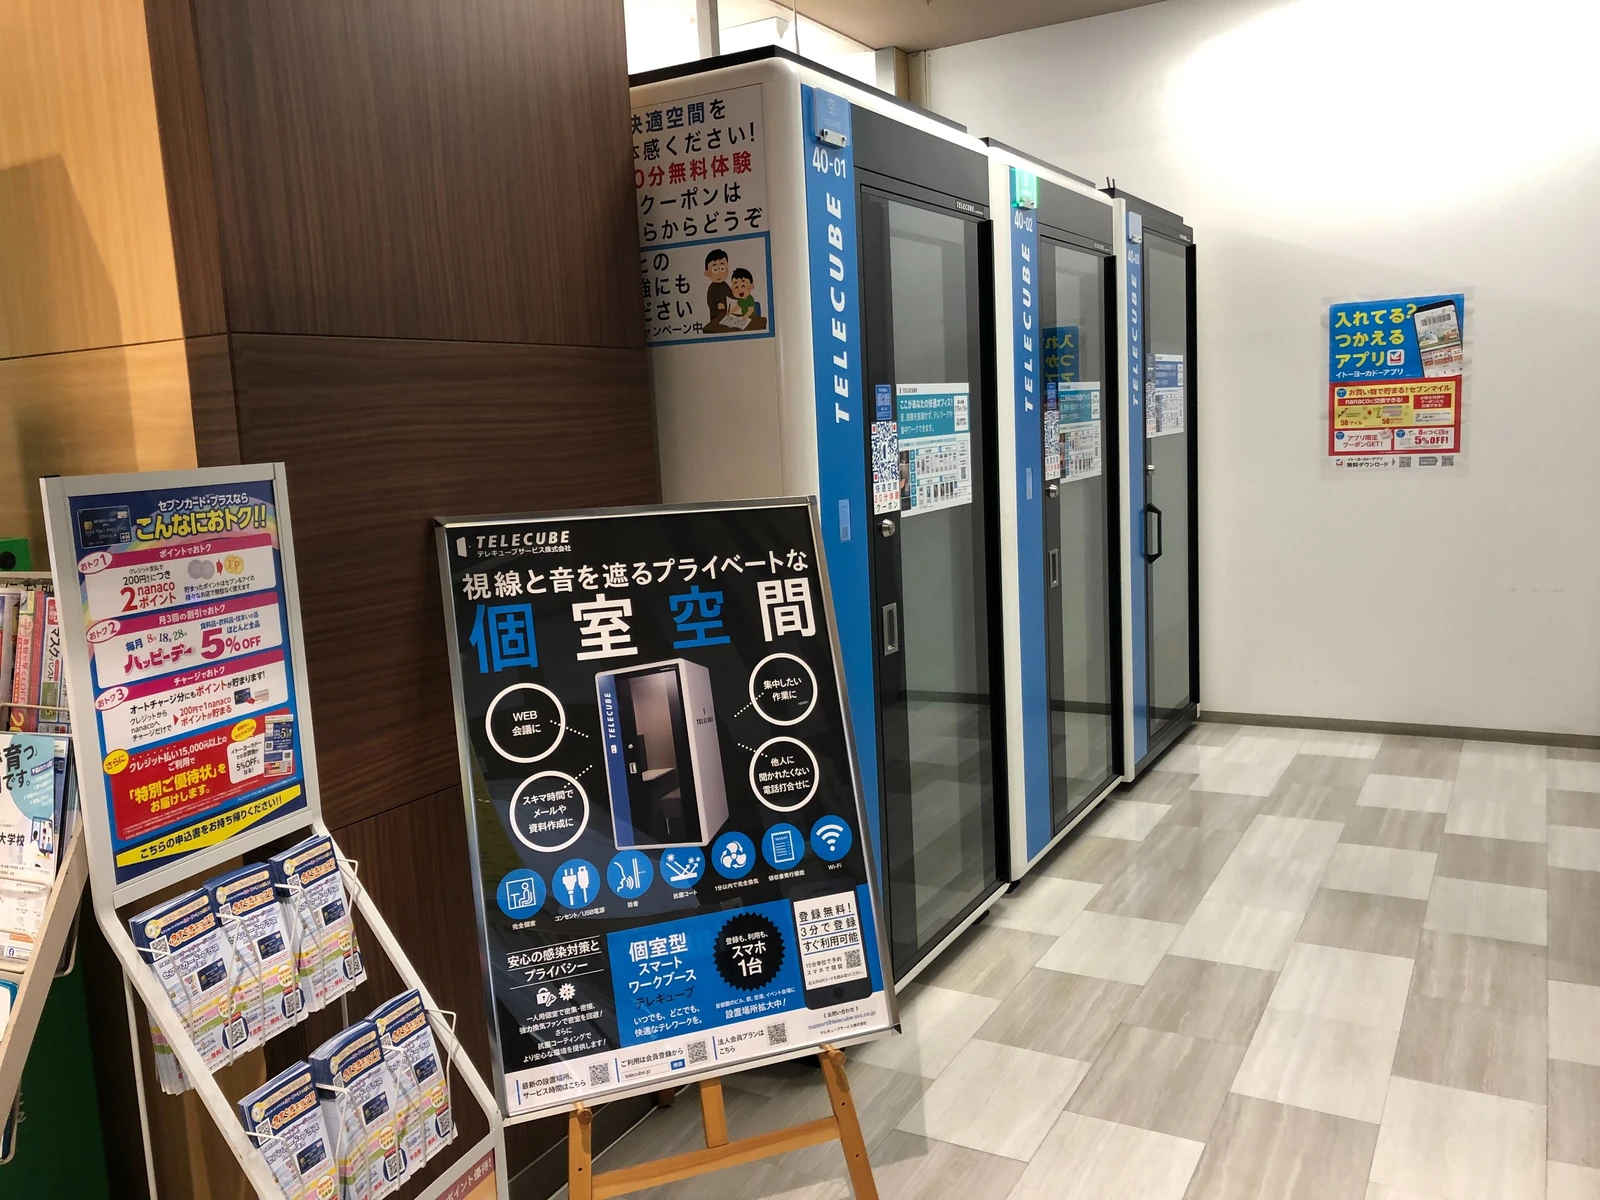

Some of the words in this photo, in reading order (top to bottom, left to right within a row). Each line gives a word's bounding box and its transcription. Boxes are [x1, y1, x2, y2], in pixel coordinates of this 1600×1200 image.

[812, 146, 846, 179] 40-01
[640, 181, 742, 216] クーポンは
[642, 207, 763, 243] らからどうぞ
[1014, 210, 1034, 233] 40-02
[826, 192, 850, 424] TELECUBE
[1335, 303, 1417, 329] 入れてる?
[1021, 242, 1035, 413] TELECUBE
[1130, 273, 1140, 408] TELECUBE
[1335, 329, 1405, 348] つかえる
[1335, 350, 1385, 369] アプリ
[1335, 368, 1404, 379] イトーヨーカドーアプリ
[1414, 436, 1449, 445] 5%OFF!
[158, 493, 249, 513] セブンカード・プラスなら
[136, 504, 267, 541] こんなにおトク!!
[476, 530, 570, 549] TELECUBE
[159, 543, 212, 559] ポイントでおトク
[477, 545, 572, 558] テレキューブサービス株式会社
[80, 553, 108, 572] おトク1
[462, 548, 809, 601] 視線と音を遮るプライベートな
[137, 581, 176, 597] nanaco
[120, 586, 138, 613] 2
[139, 592, 177, 609] ポイント
[158, 604, 226, 626] 月3回の割引でおトク
[88, 621, 118, 643] おトク2
[226, 619, 261, 635] ほとんど全品
[469, 577, 817, 674] 個室空間
[125, 637, 144, 653] 毎月
[173, 666, 226, 687] チャージでおトク
[763, 677, 803, 690] 集中したい
[97, 688, 126, 709] おトク3
[772, 690, 798, 702] 作業に
[130, 710, 168, 726] クレジットから
[181, 705, 232, 727] ポイントが貯まる
[512, 710, 538, 722] WEB
[603, 692, 617, 739] TELECUBE
[132, 724, 172, 742] チャージだけで
[511, 724, 542, 737] 会議に
[105, 754, 126, 770] さらに
[168, 757, 196, 772] ご利用で
[770, 755, 795, 767] 他人に
[129, 763, 226, 804] 「特別ご優待状」を
[758, 766, 811, 782] 聞かれたくない
[762, 780, 811, 795] 電話打合せに
[150, 784, 210, 813] お届けします。
[522, 789, 574, 806] スキマ時間で
[533, 804, 567, 819] メールや
[140, 795, 283, 859] こちらの申込書をお持ち帰りください!!
[528, 818, 575, 835] 資料作成に
[828, 863, 843, 871] Wi-Fi
[714, 877, 760, 892] 1分以内で完全換気
[799, 902, 852, 922] 登録無料!
[512, 920, 537, 931] 完全個室
[800, 917, 857, 937] 3分で登録
[629, 932, 688, 962] 個室型
[725, 931, 769, 946] 登録も、利用も、
[803, 932, 859, 952] すぐ利用可能
[507, 940, 600, 969] 安心の感染対策と
[732, 941, 767, 959] スマホ
[524, 963, 588, 982] プライバシー
[639, 956, 683, 976] スマート
[738, 957, 763, 977] 1台
[629, 969, 697, 994] ワークブース
[634, 985, 695, 1010] テレキューブ
[725, 998, 786, 1020] 設置場所拡大中!
[555, 1027, 573, 1037] さらに
[634, 1016, 703, 1038] 快適なテレワークを。
[537, 1032, 592, 1051] 抗菌コーティングで
[717, 1029, 765, 1046] 法人会員プランは
[523, 1038, 607, 1064] より安心な環境を提供します!
[620, 1047, 684, 1068] ご利用は会員登録から
[719, 1045, 736, 1056] こちら
[522, 1072, 573, 1090] 最新の設置場所、
[624, 1069, 652, 1080] telecube.jp
[522, 1079, 587, 1099] サービス時間はこちら
